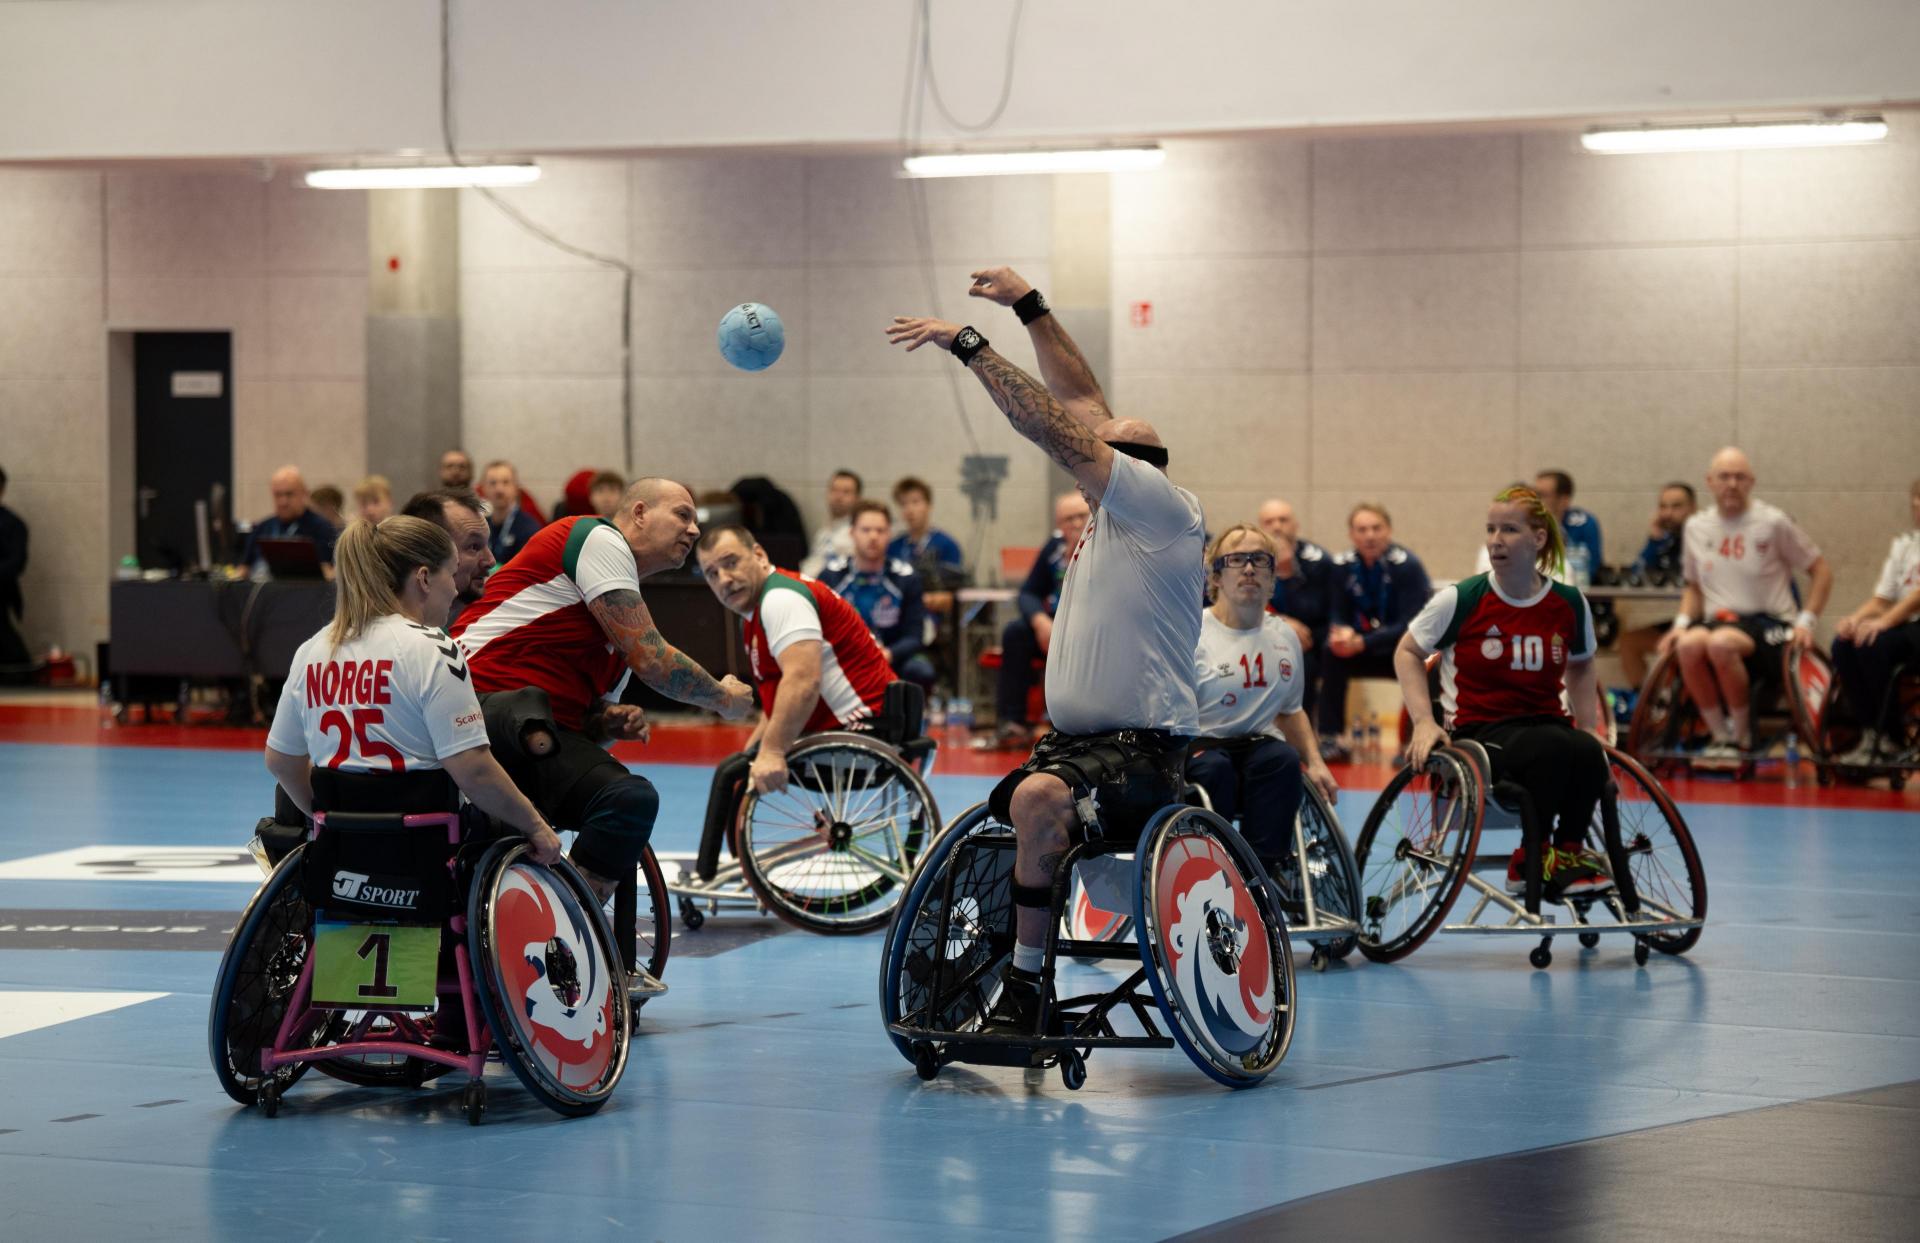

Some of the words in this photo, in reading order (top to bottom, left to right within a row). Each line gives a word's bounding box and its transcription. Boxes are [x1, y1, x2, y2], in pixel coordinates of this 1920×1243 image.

[1718, 534, 1744, 560] 46
[1239, 652, 1267, 689] 11
[1510, 634, 1544, 671] 10
[306, 660, 393, 709] NORGE
[319, 708, 406, 774] 25
[360, 886, 420, 906] SPORT
[357, 933, 397, 997] 1
